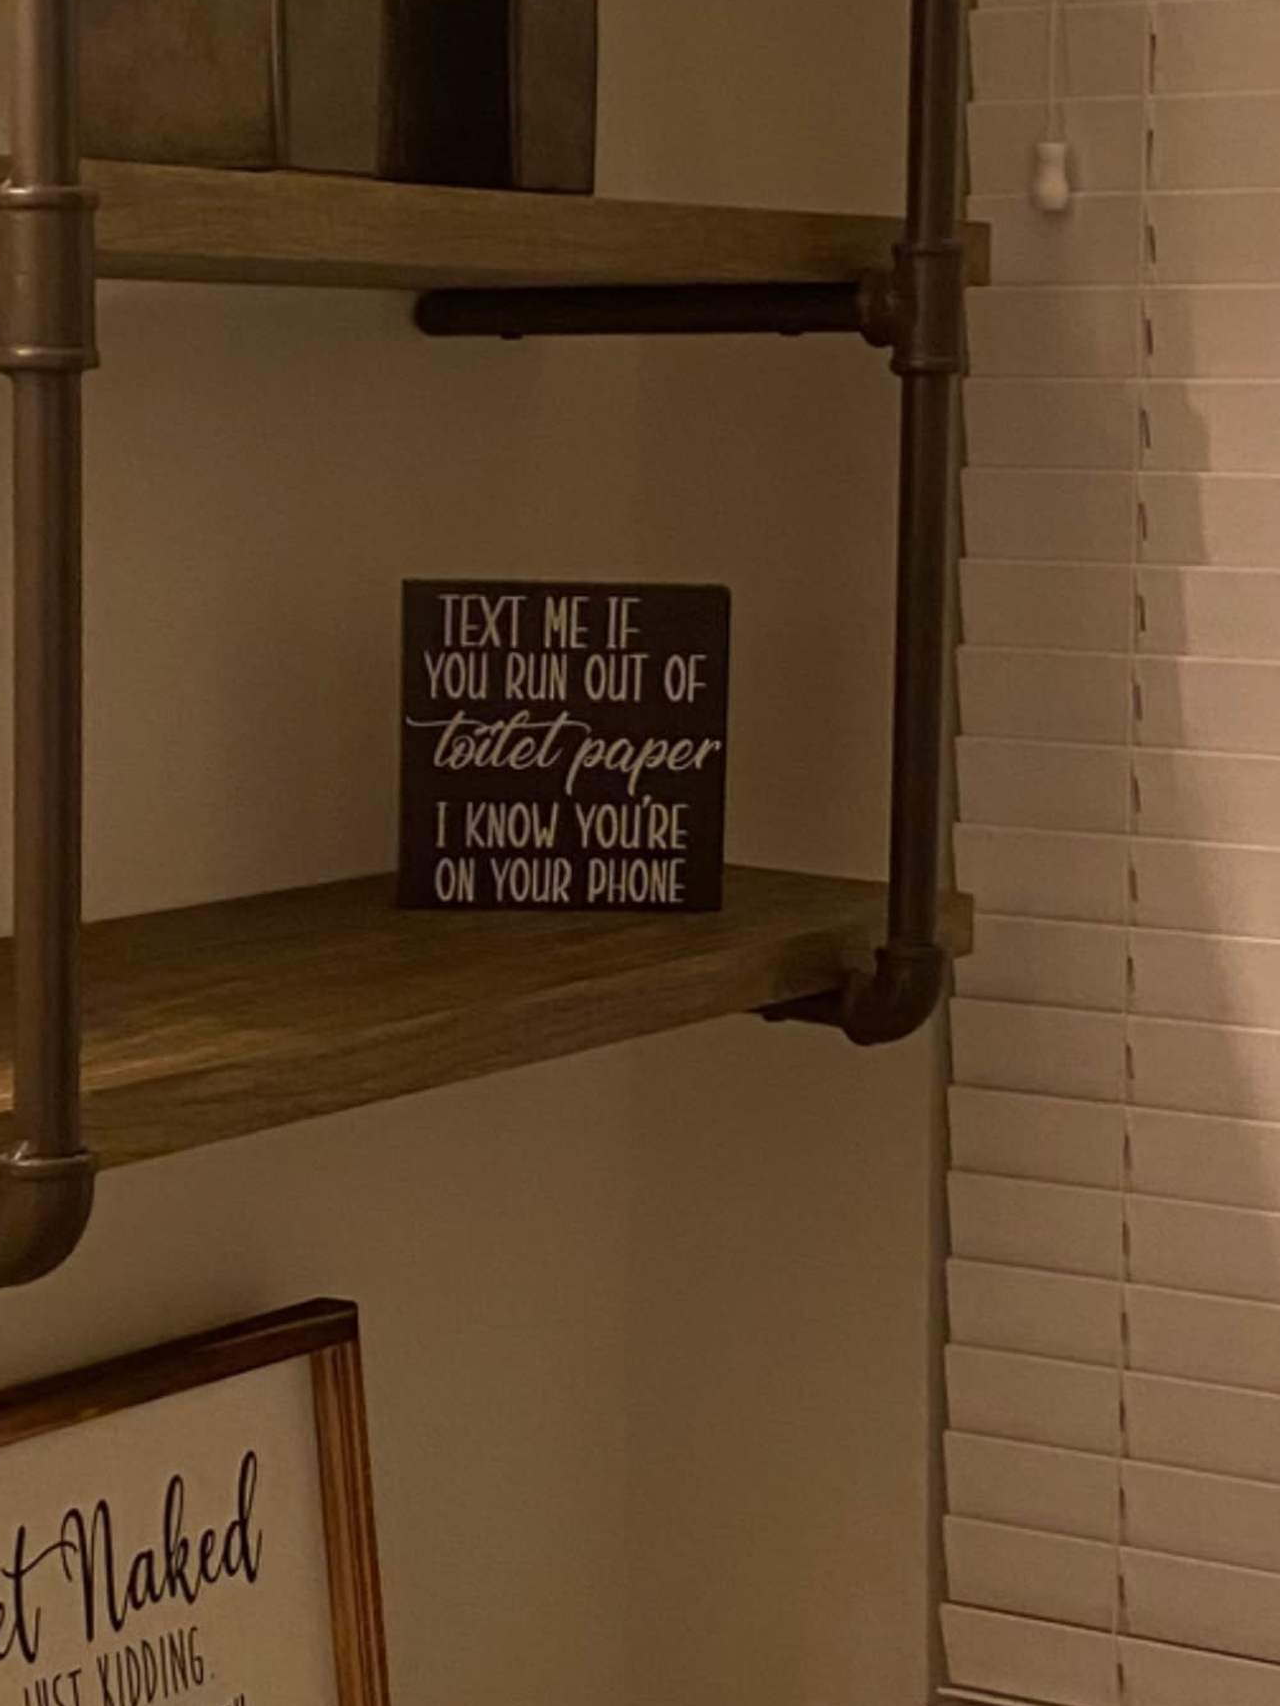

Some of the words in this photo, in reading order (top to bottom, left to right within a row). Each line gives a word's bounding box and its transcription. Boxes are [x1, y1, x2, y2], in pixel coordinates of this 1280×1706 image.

[439, 594, 526, 648] TEXT
[544, 595, 590, 649] ME
[606, 595, 641, 650] IF
[423, 649, 487, 700] YOU
[505, 651, 567, 701] RUN
[583, 653, 648, 703] OUT
[663, 654, 708, 703] OF
[405, 709, 592, 771] toilet
[564, 736, 722, 796] paper
[435, 800, 447, 849] I
[466, 801, 559, 849] KNOW
[575, 794, 689, 851] YOU'RE
[434, 857, 475, 903] ON
[489, 857, 570, 903] YOUR
[587, 857, 686, 904] PHONE
[58, 1449, 263, 1643] Naked
